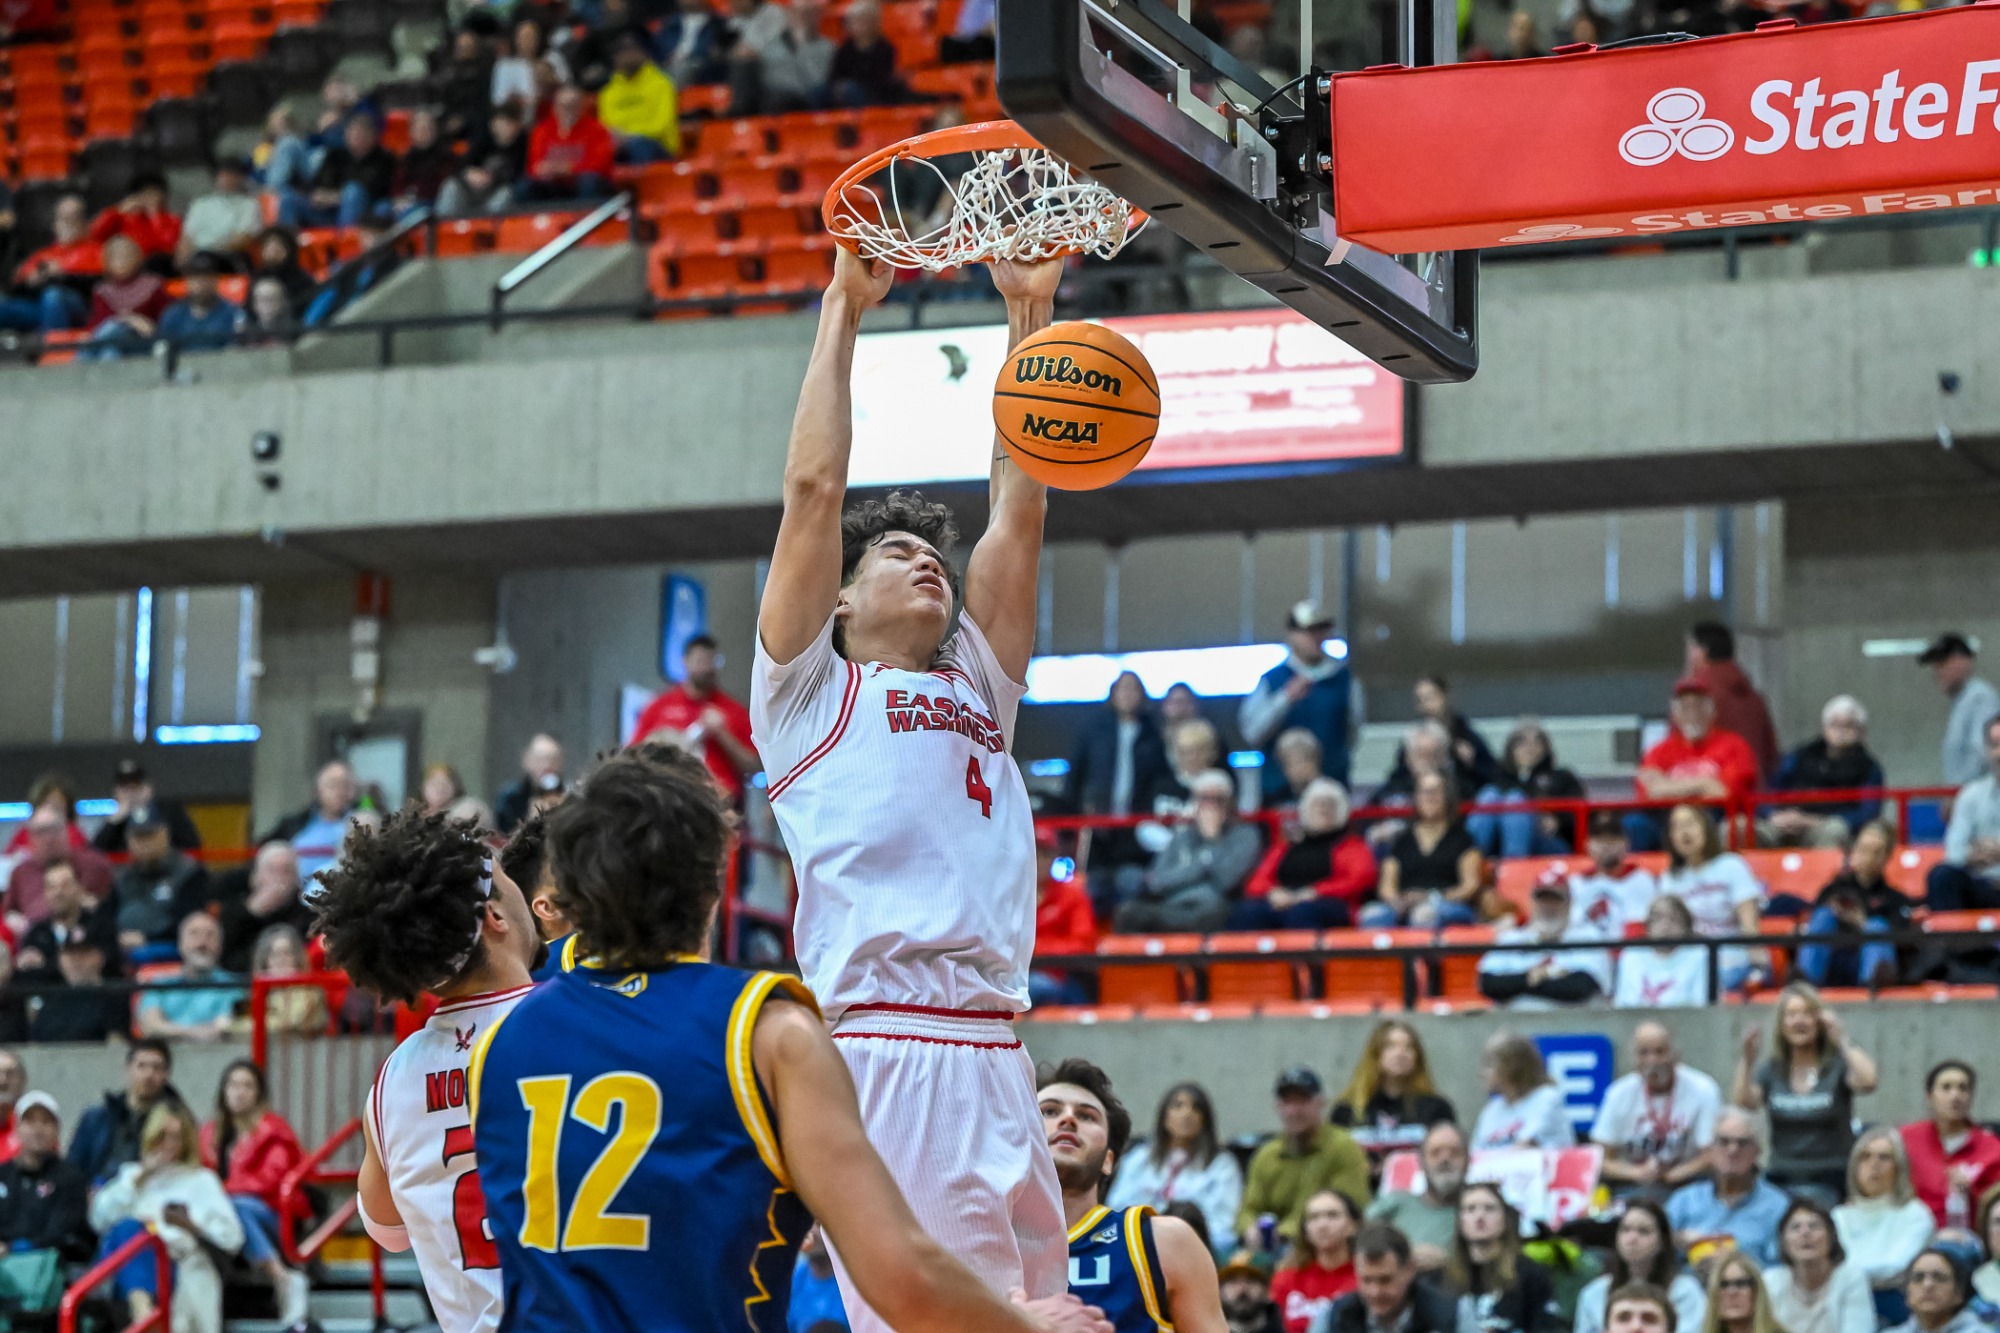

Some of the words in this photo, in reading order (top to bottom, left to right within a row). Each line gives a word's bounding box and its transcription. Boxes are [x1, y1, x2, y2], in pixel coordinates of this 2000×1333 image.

[1745, 69, 1949, 155] State
[1956, 60, 2000, 136] F
[1631, 203, 1851, 233] State
[1015, 355, 1122, 398] Wilson
[1021, 413, 1099, 445] NCAA
[966, 755, 993, 819] 4
[425, 1066, 471, 1113] MO
[517, 1071, 662, 1253] 12
[1069, 1254, 1110, 1286] U
